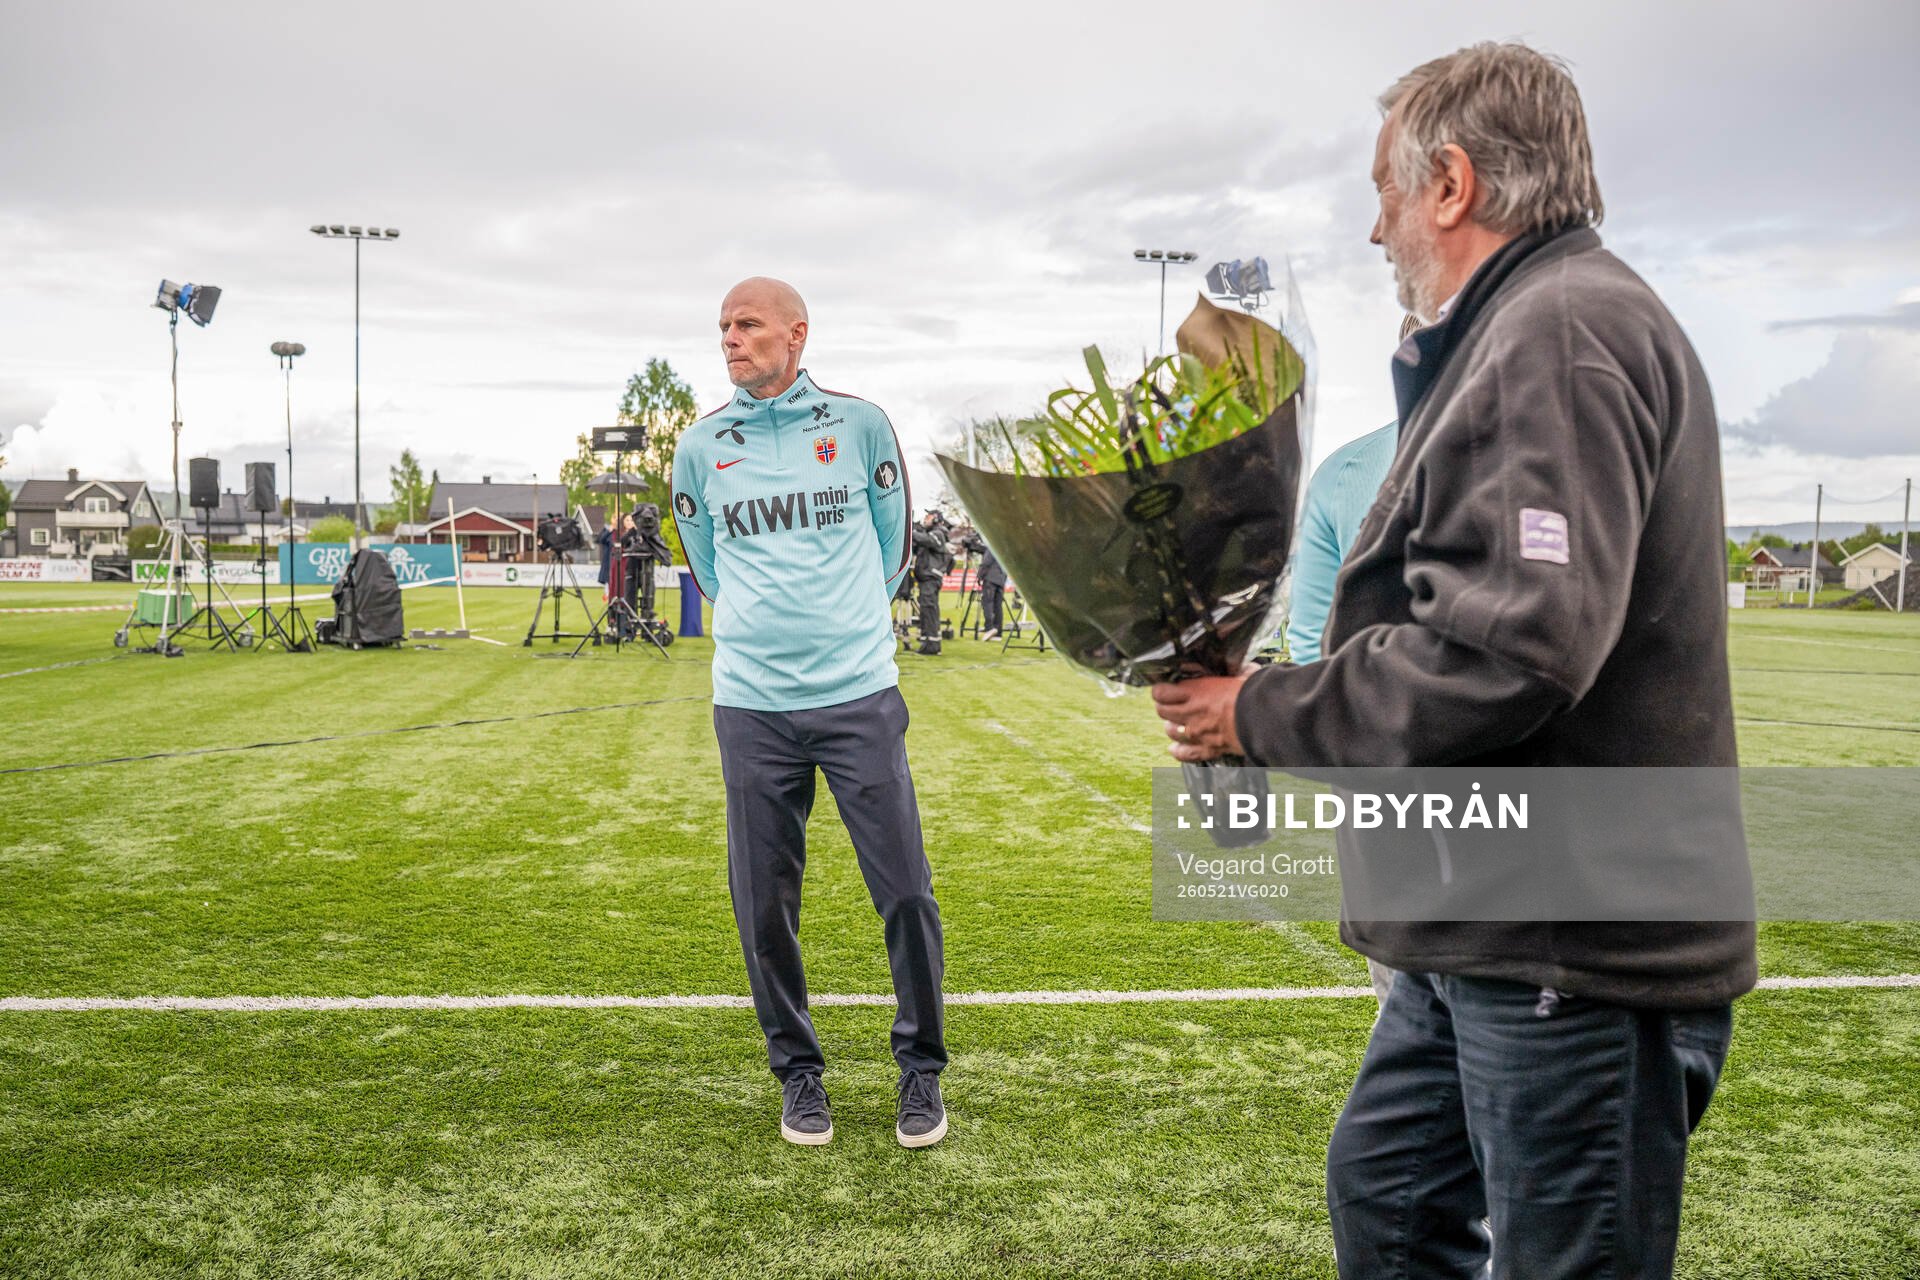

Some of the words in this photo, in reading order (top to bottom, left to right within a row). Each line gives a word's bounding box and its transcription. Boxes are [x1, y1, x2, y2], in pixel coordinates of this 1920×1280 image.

[802, 424, 820, 433] Norsk
[821, 417, 845, 428] Tipping
[812, 485, 848, 507] mini
[722, 492, 809, 538] KIWI
[815, 505, 845, 531] pris
